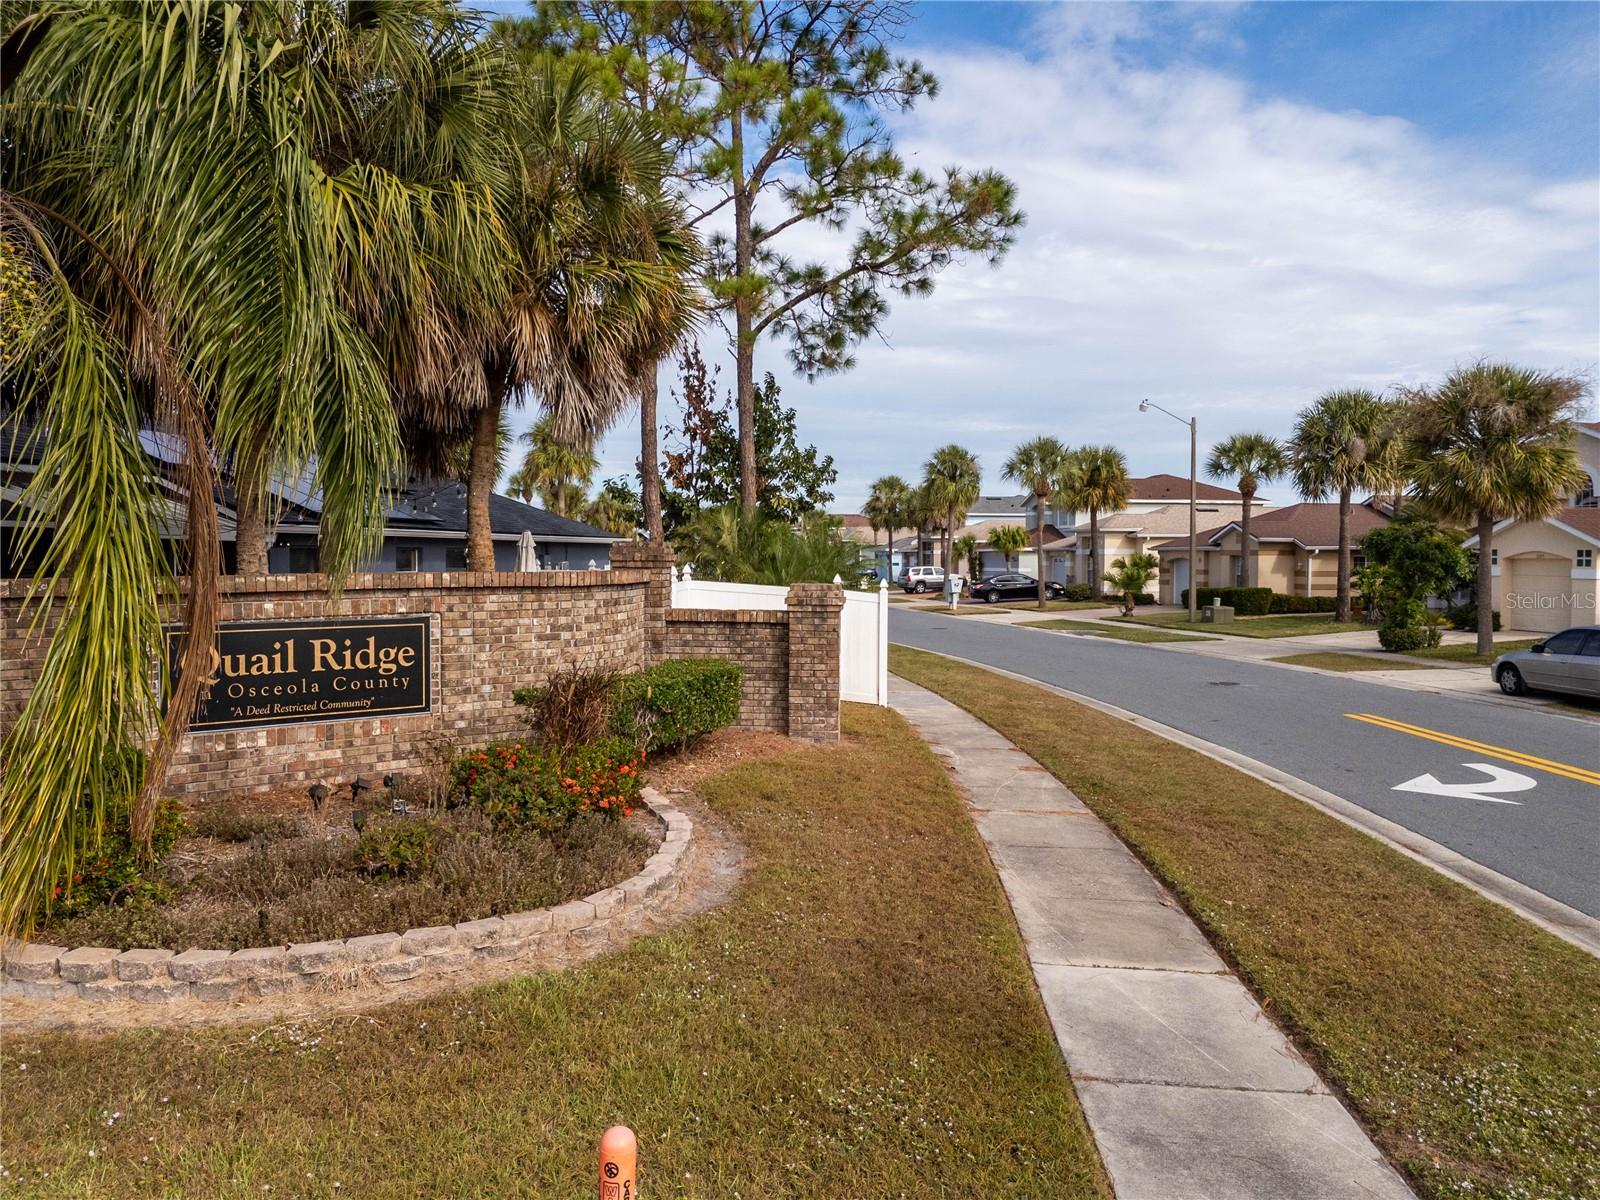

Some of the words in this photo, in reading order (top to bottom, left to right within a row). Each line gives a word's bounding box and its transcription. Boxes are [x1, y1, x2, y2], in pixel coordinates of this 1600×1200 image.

[309, 636, 415, 675] Ridge
[228, 678, 319, 698] Osceola
[333, 676, 410, 691] County
[246, 703, 271, 716] Deed
[273, 700, 317, 714] Restricted
[320, 696, 375, 710] Community"
